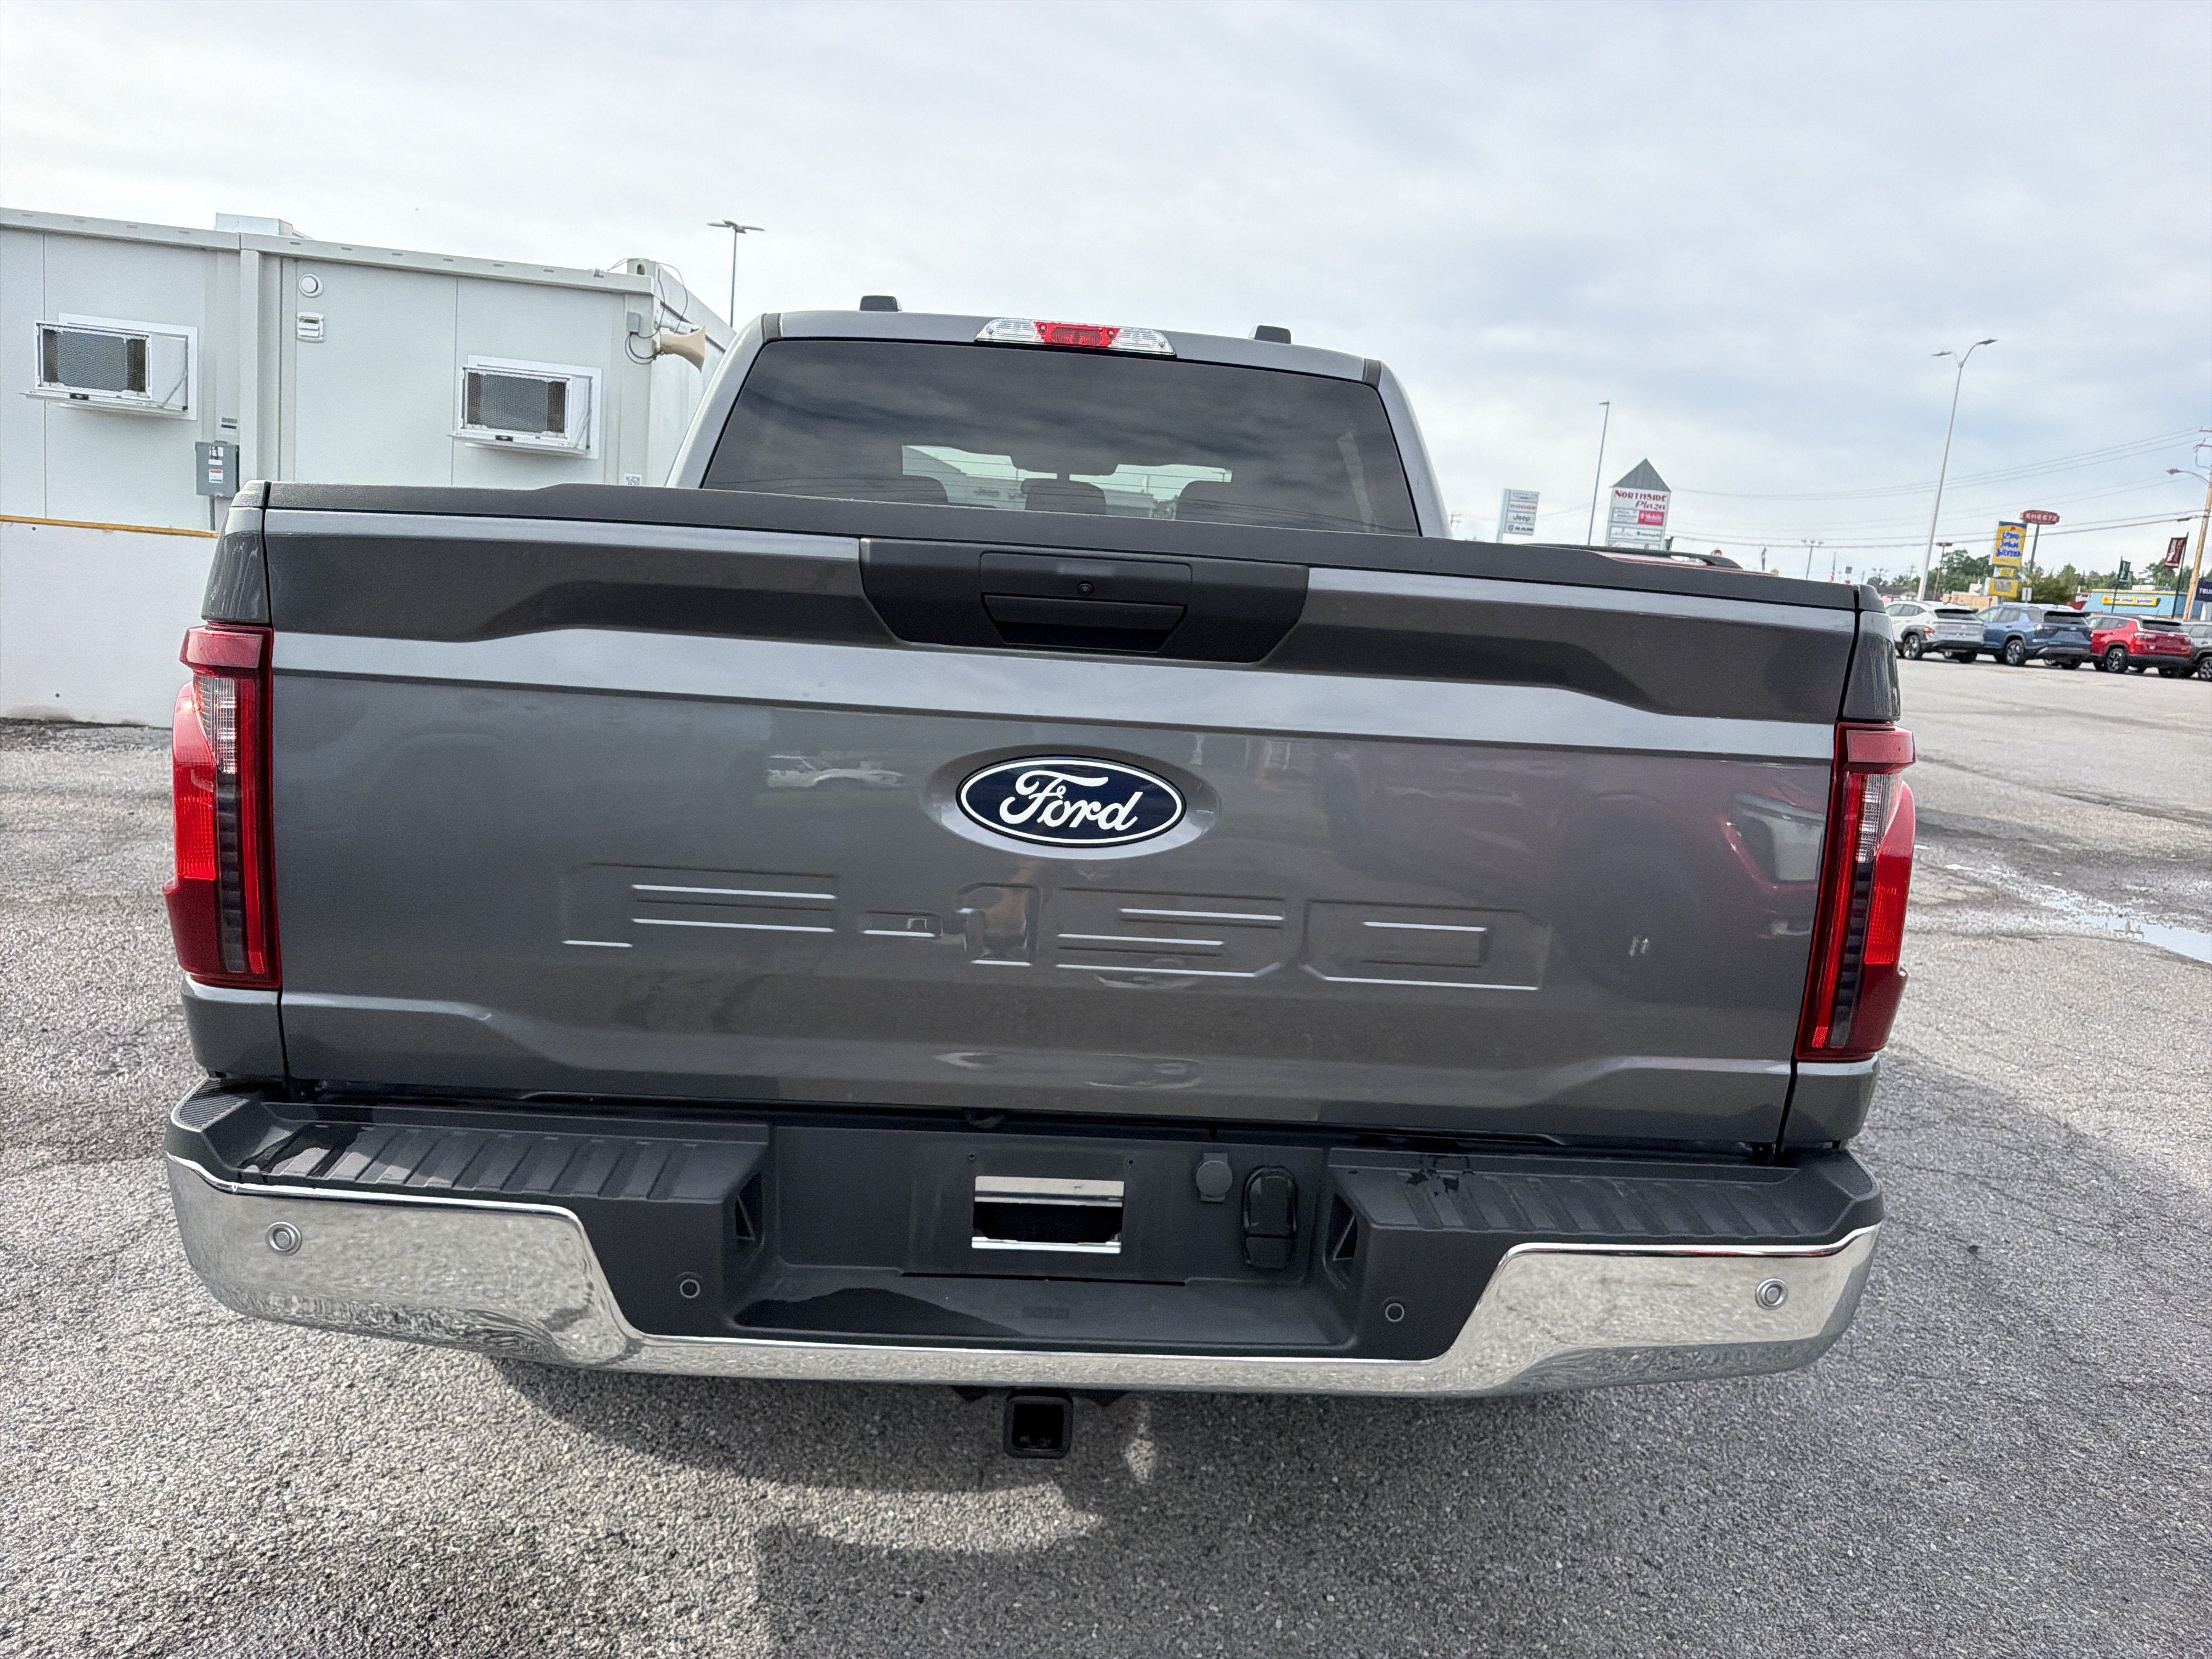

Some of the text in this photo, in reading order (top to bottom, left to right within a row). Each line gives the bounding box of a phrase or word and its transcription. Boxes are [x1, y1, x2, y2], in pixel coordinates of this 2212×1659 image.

[1635, 500, 1666, 510] Plaza
[999, 770, 1143, 831] Ford
[560, 862, 1551, 991] F-150
